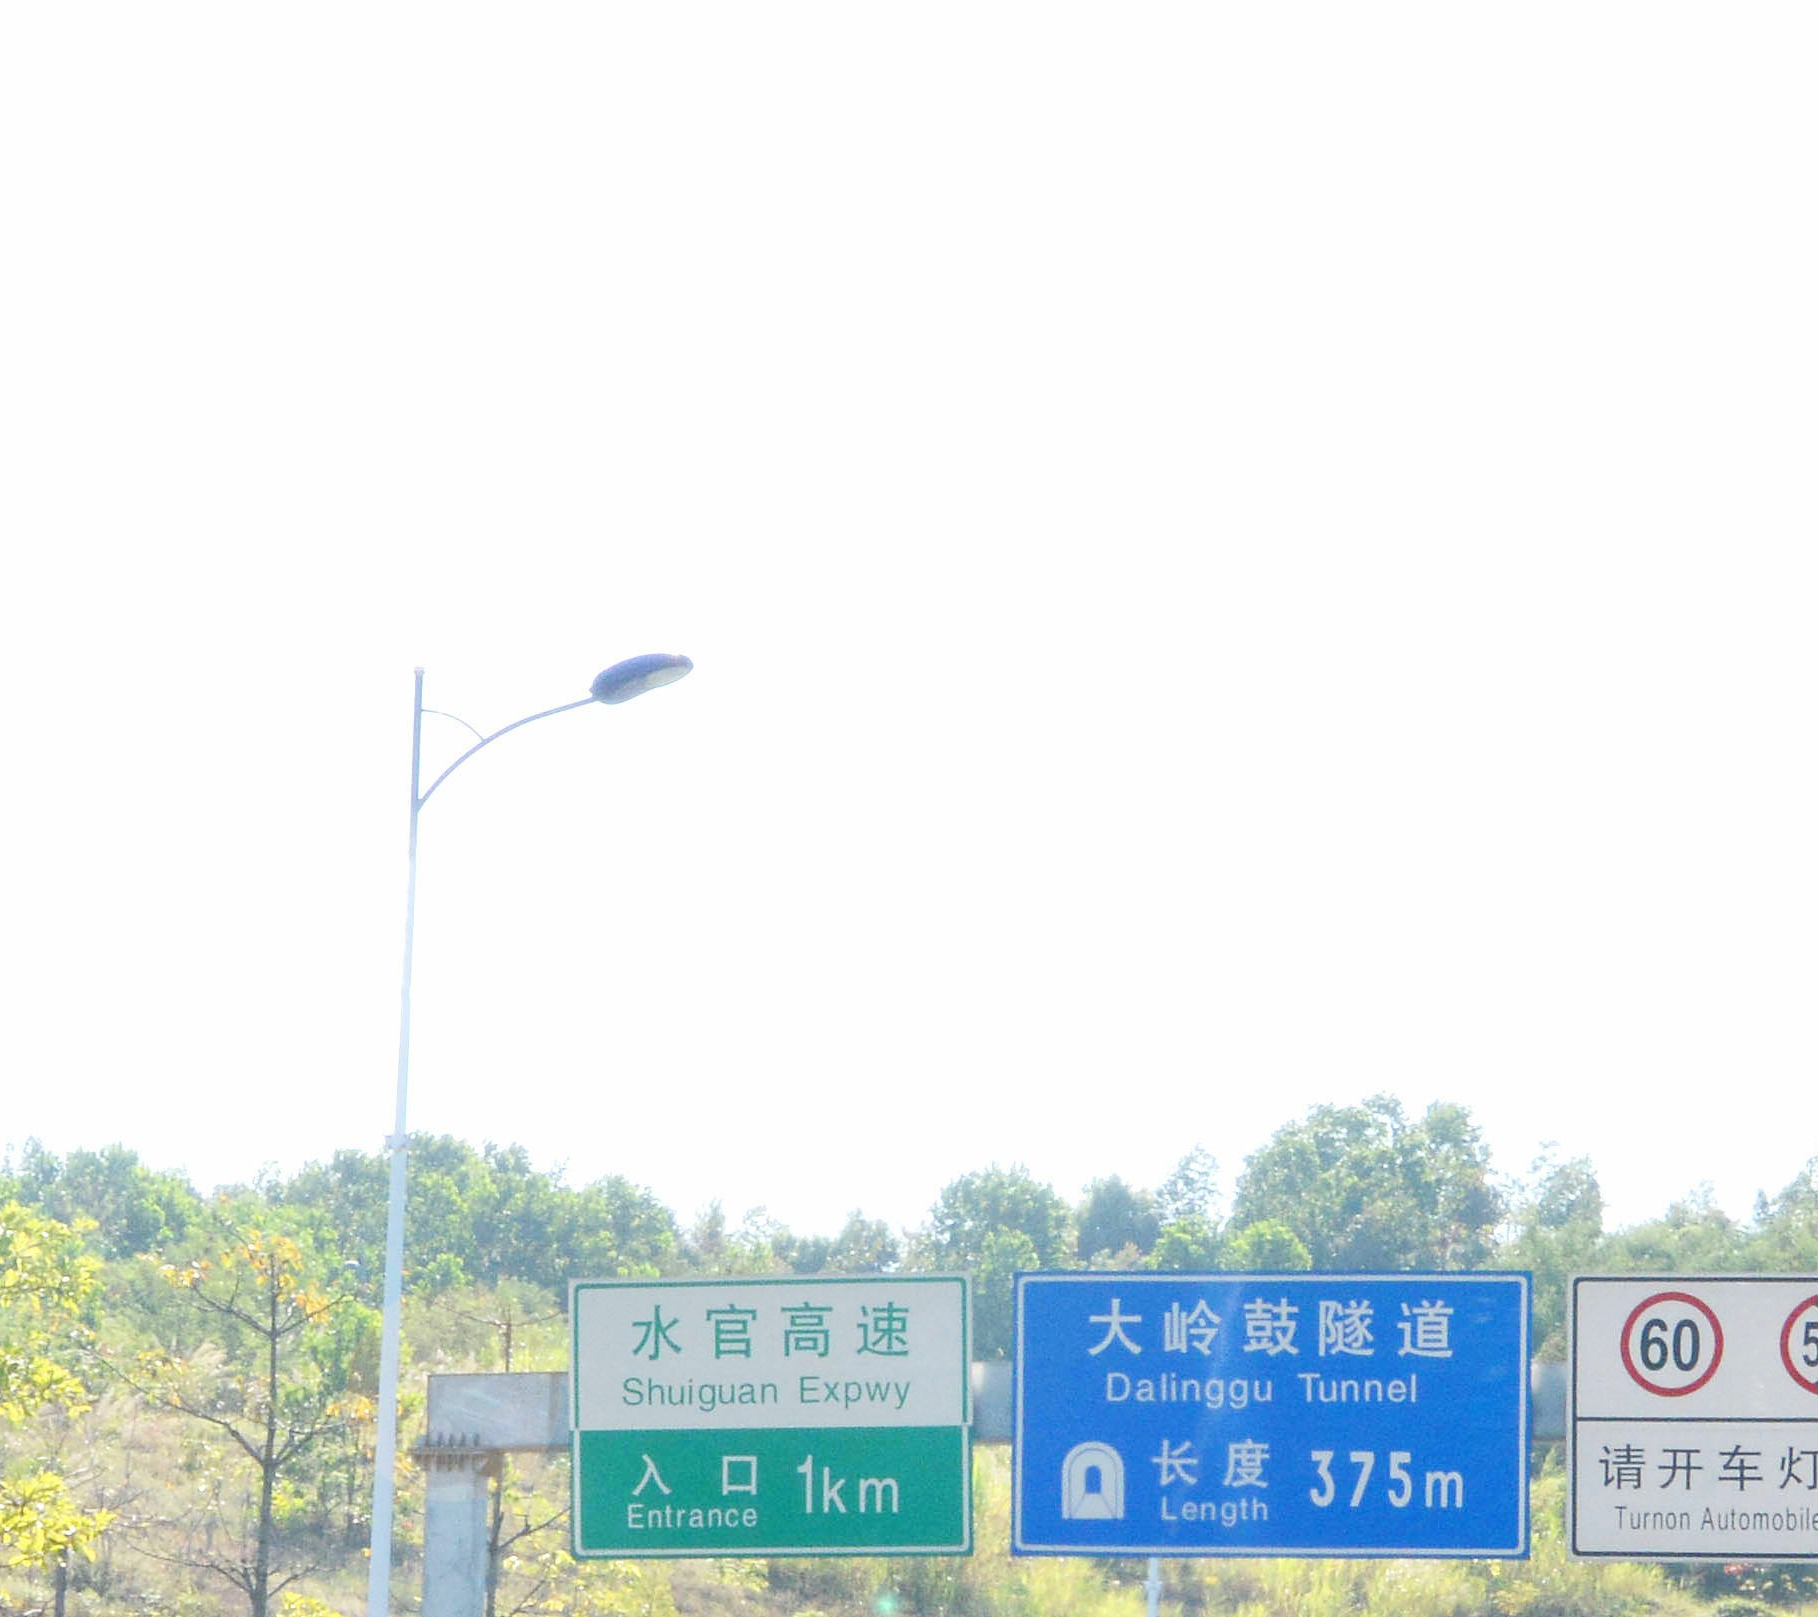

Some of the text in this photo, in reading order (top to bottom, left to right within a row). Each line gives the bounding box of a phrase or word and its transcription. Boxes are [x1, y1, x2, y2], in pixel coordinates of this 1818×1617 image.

[632, 1302, 909, 1360] 水官高速
[1089, 1298, 1453, 1357] 大岭鼓隧道
[1639, 1318, 1701, 1371] 60
[623, 1376, 910, 1412] Shuiguan Expwy
[1107, 1373, 1416, 1409] Dalinggu Tunnel
[632, 1454, 898, 1513] 入口 1km
[1152, 1439, 1463, 1507] 长度 375m
[628, 1504, 757, 1528] Entrance
[1162, 1497, 1267, 1527] Length
